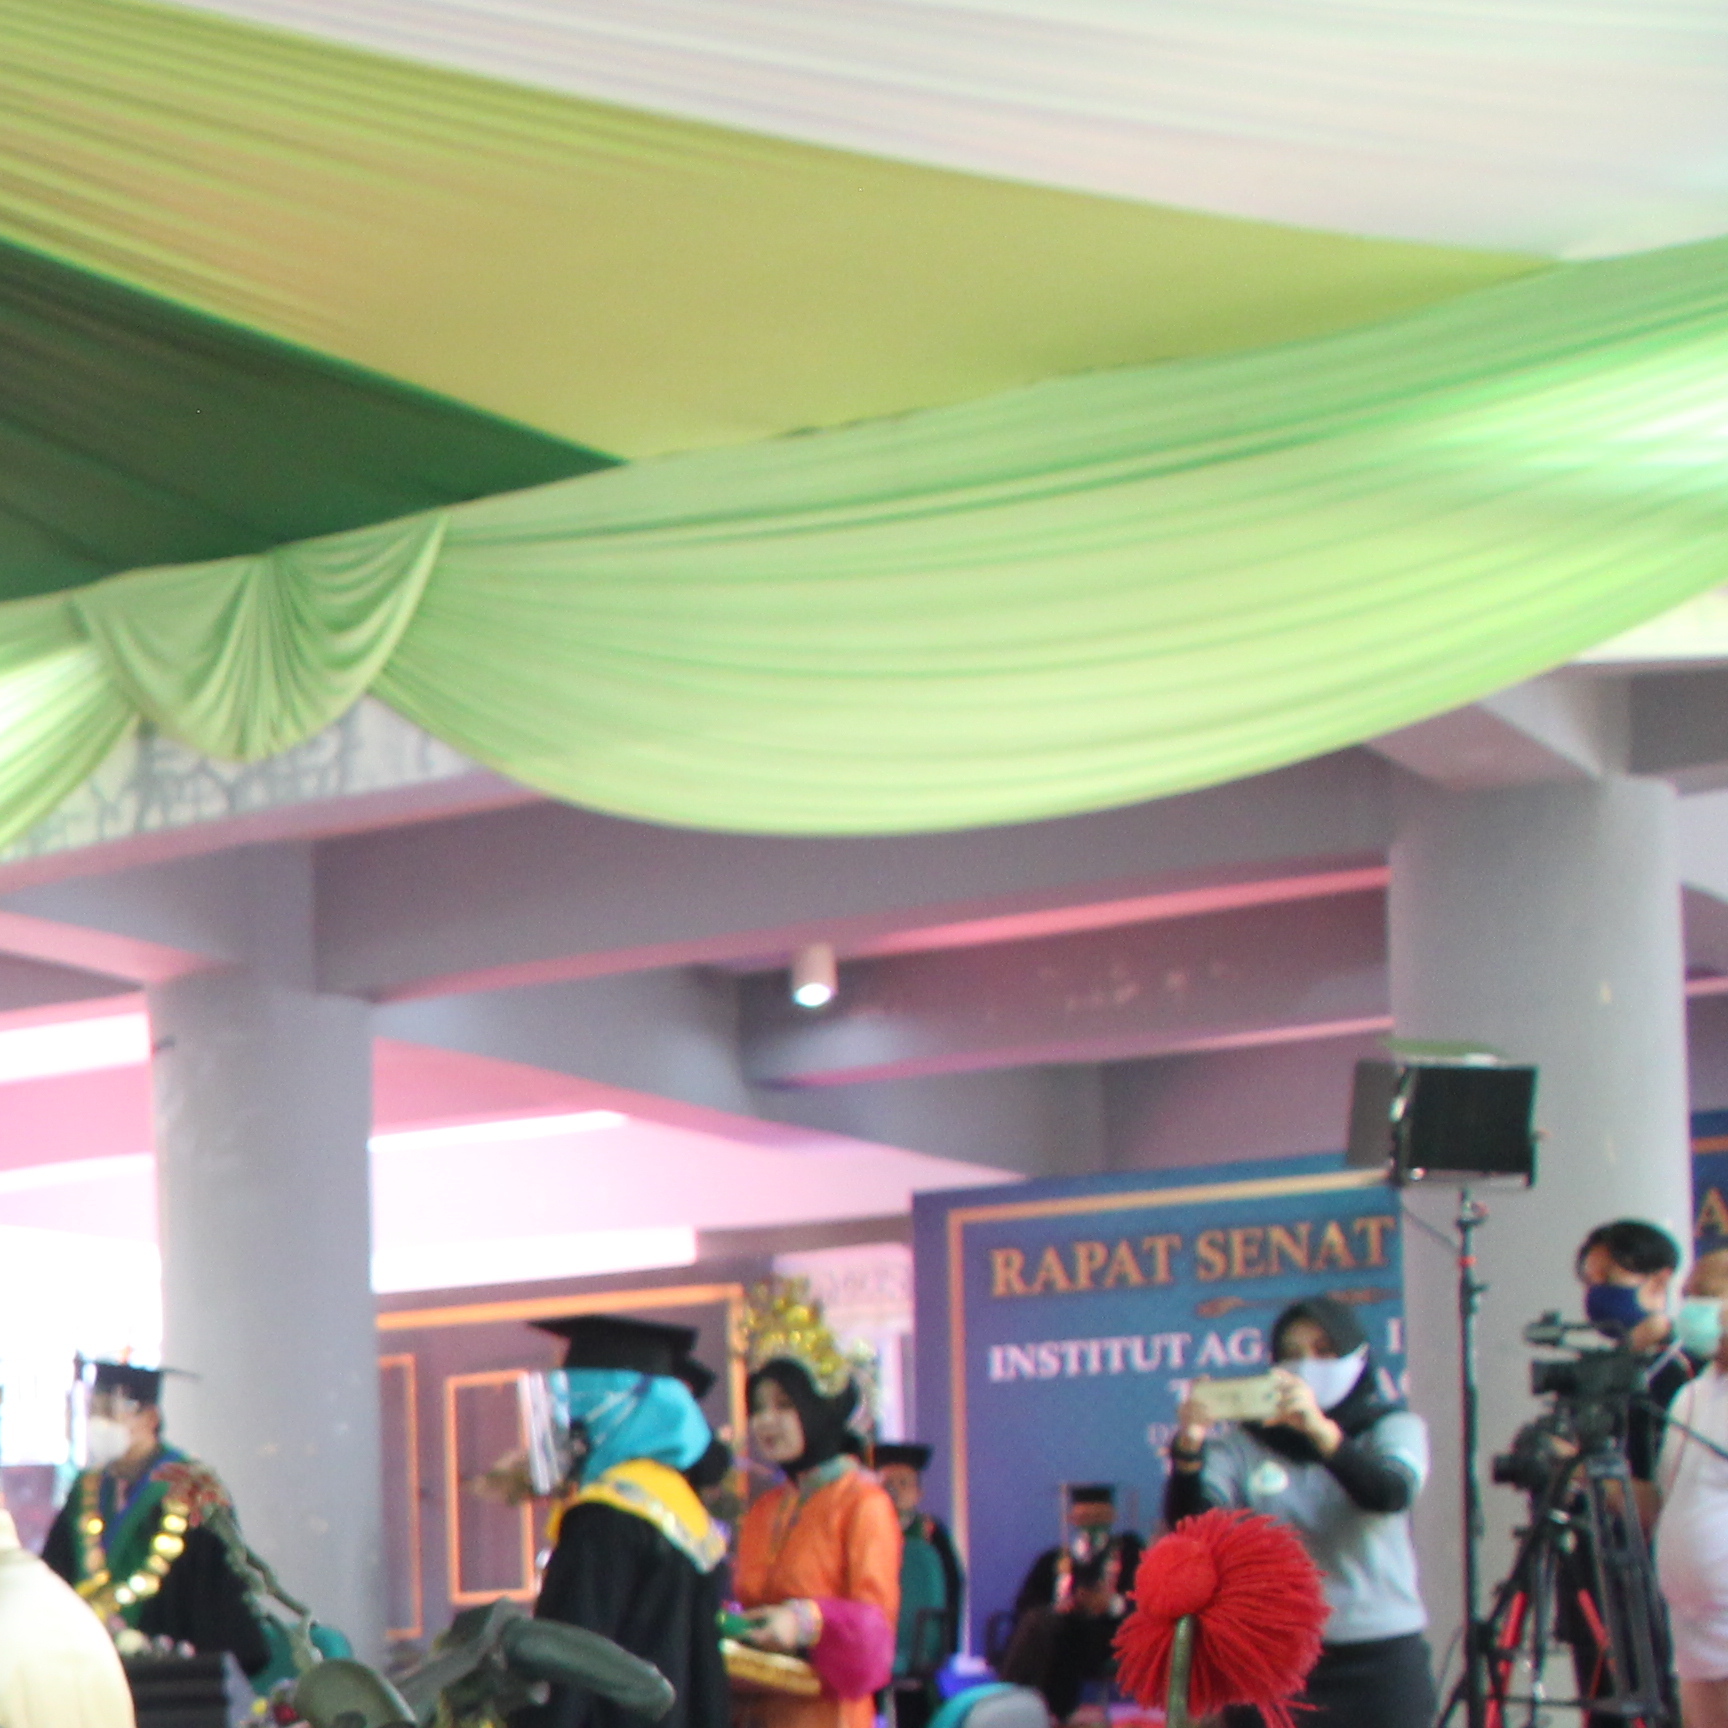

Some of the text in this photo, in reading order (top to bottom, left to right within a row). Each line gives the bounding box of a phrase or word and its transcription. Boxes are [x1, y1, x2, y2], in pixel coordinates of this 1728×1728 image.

[990, 1216, 1395, 1296] RAPAT SENAT
[988, 1332, 1192, 1383] INSTITUT
